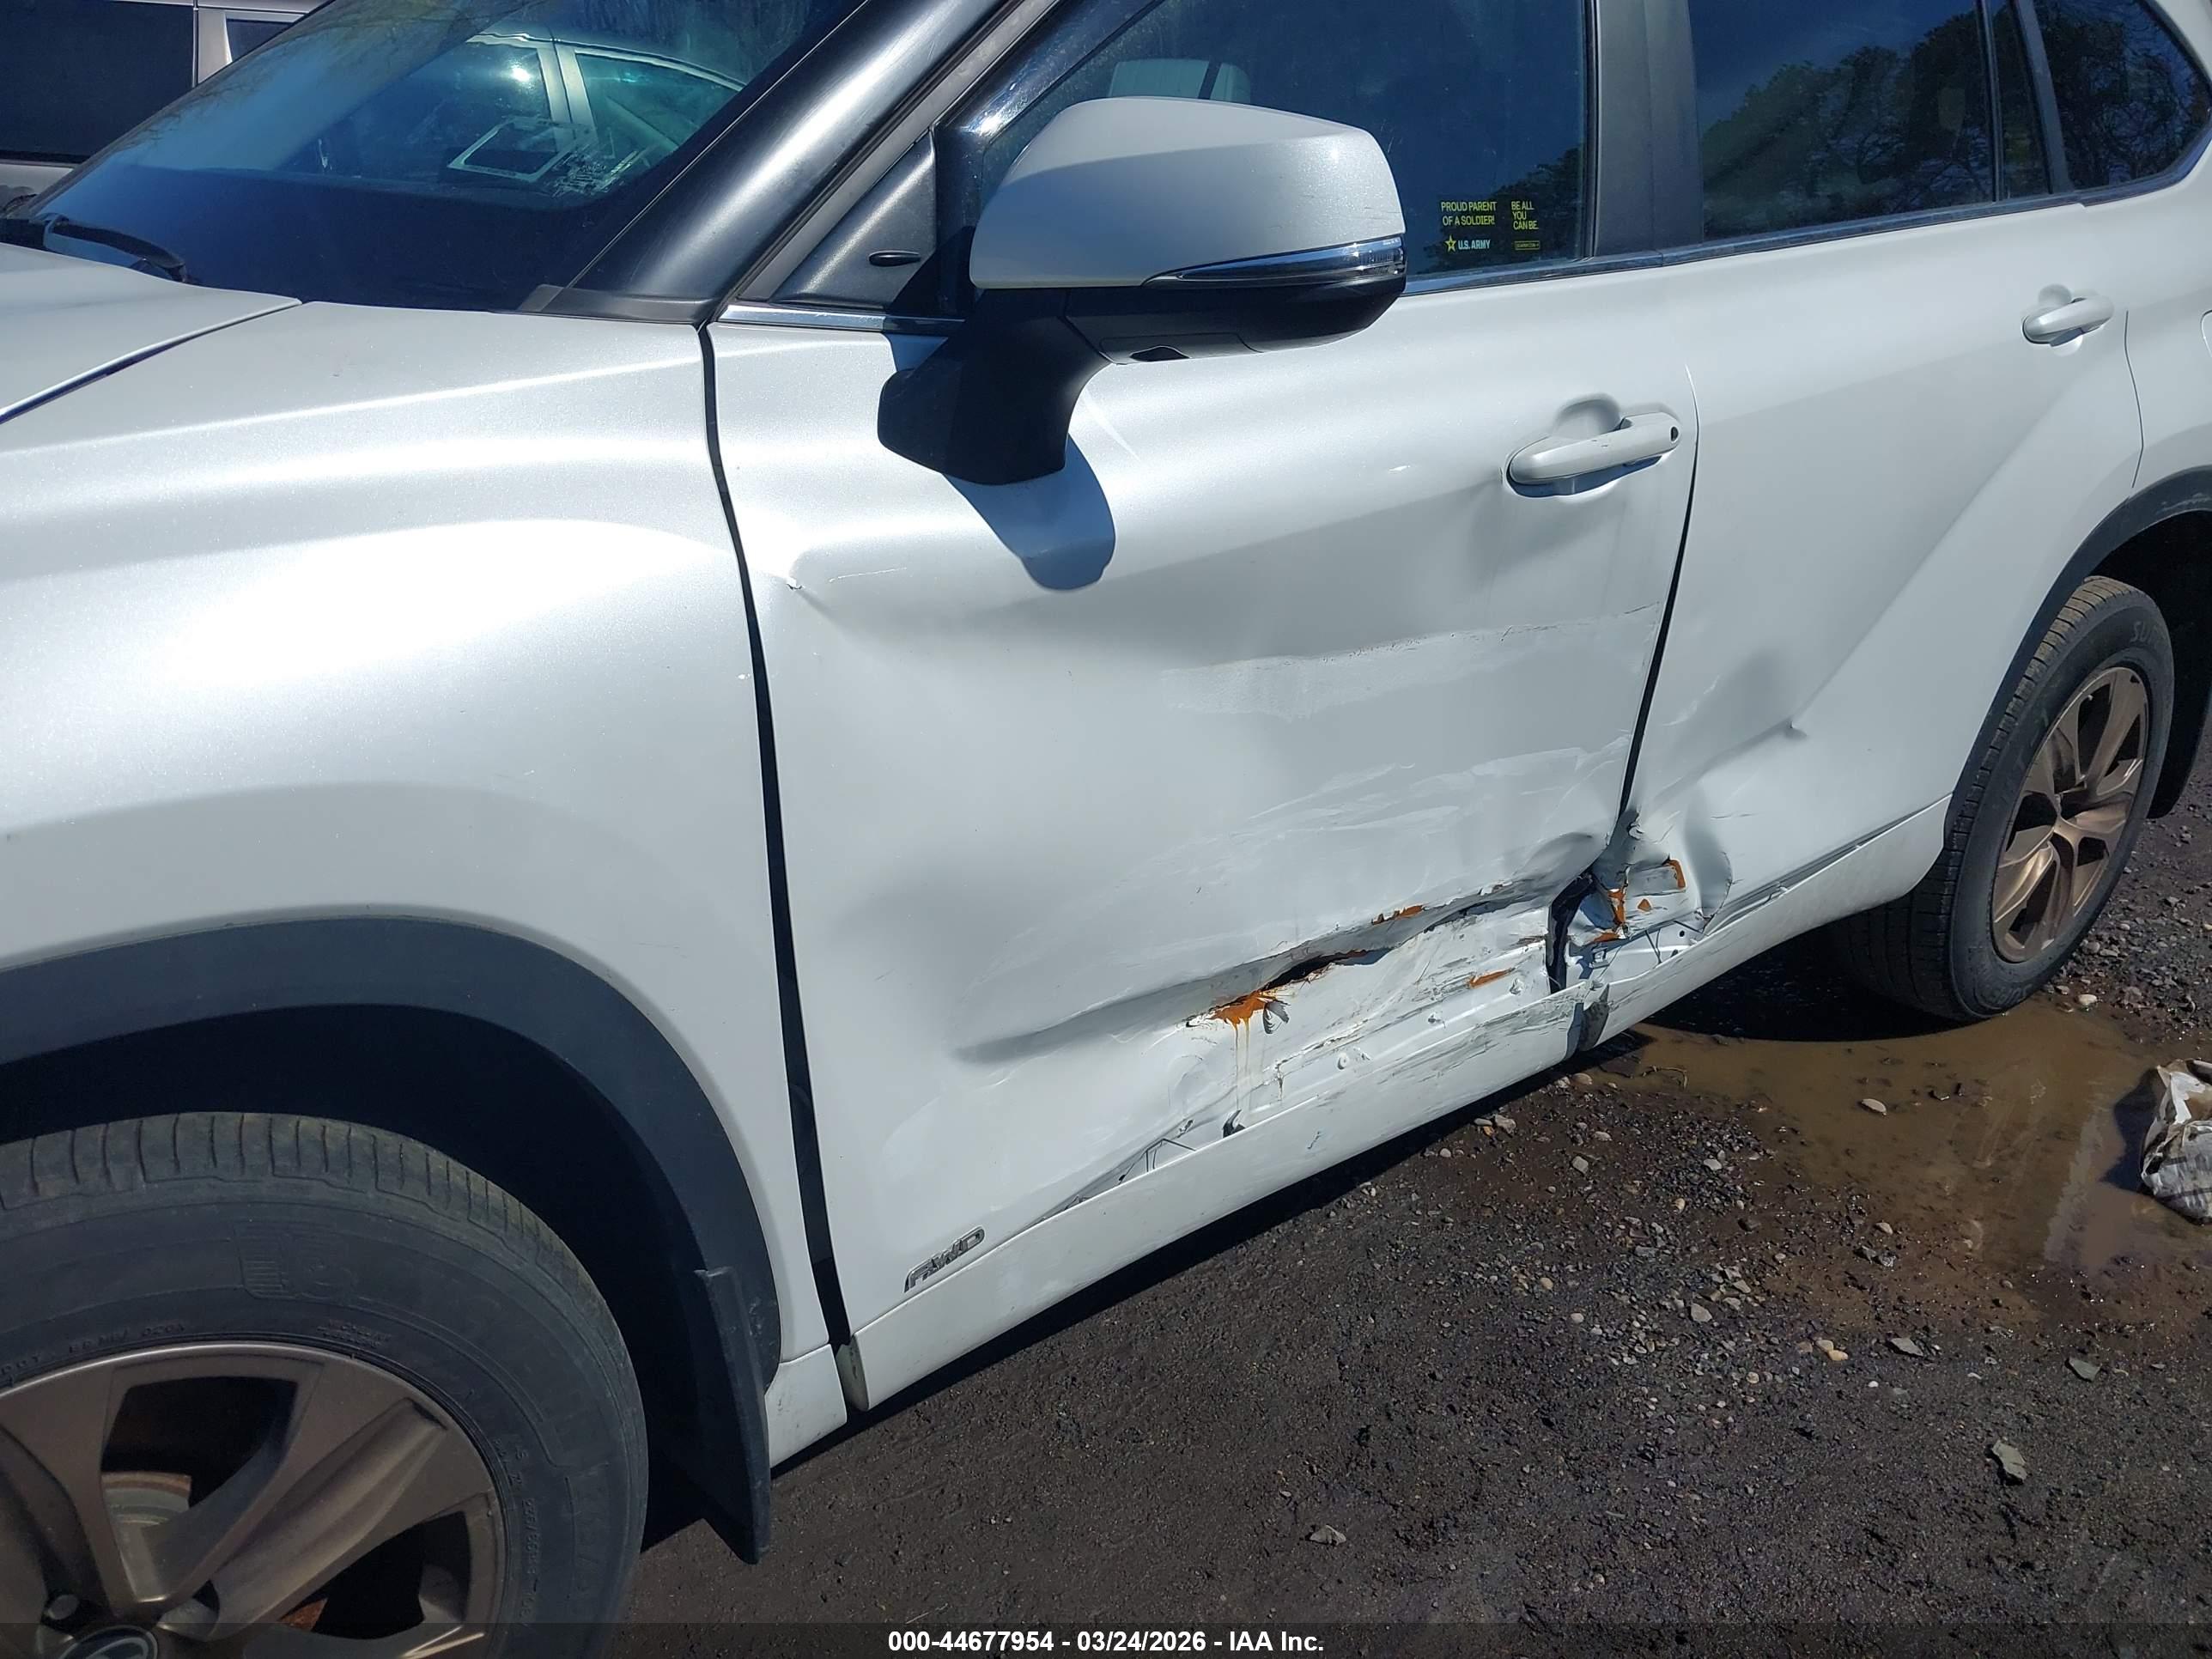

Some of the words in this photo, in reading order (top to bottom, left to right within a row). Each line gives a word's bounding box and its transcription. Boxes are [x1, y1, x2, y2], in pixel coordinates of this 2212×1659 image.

[1441, 201, 1468, 211] PROUD
[1468, 201, 1497, 211] PARENT
[1511, 201, 1521, 210] BE
[1522, 201, 1534, 210] ALL
[1512, 210, 1527, 220] YOU
[1443, 216, 1454, 226] OF
[1455, 216, 1460, 226] A
[1513, 221, 1528, 230] CAN
[1458, 240, 1470, 249] U.S.
[1471, 239, 1491, 249] ARMY
